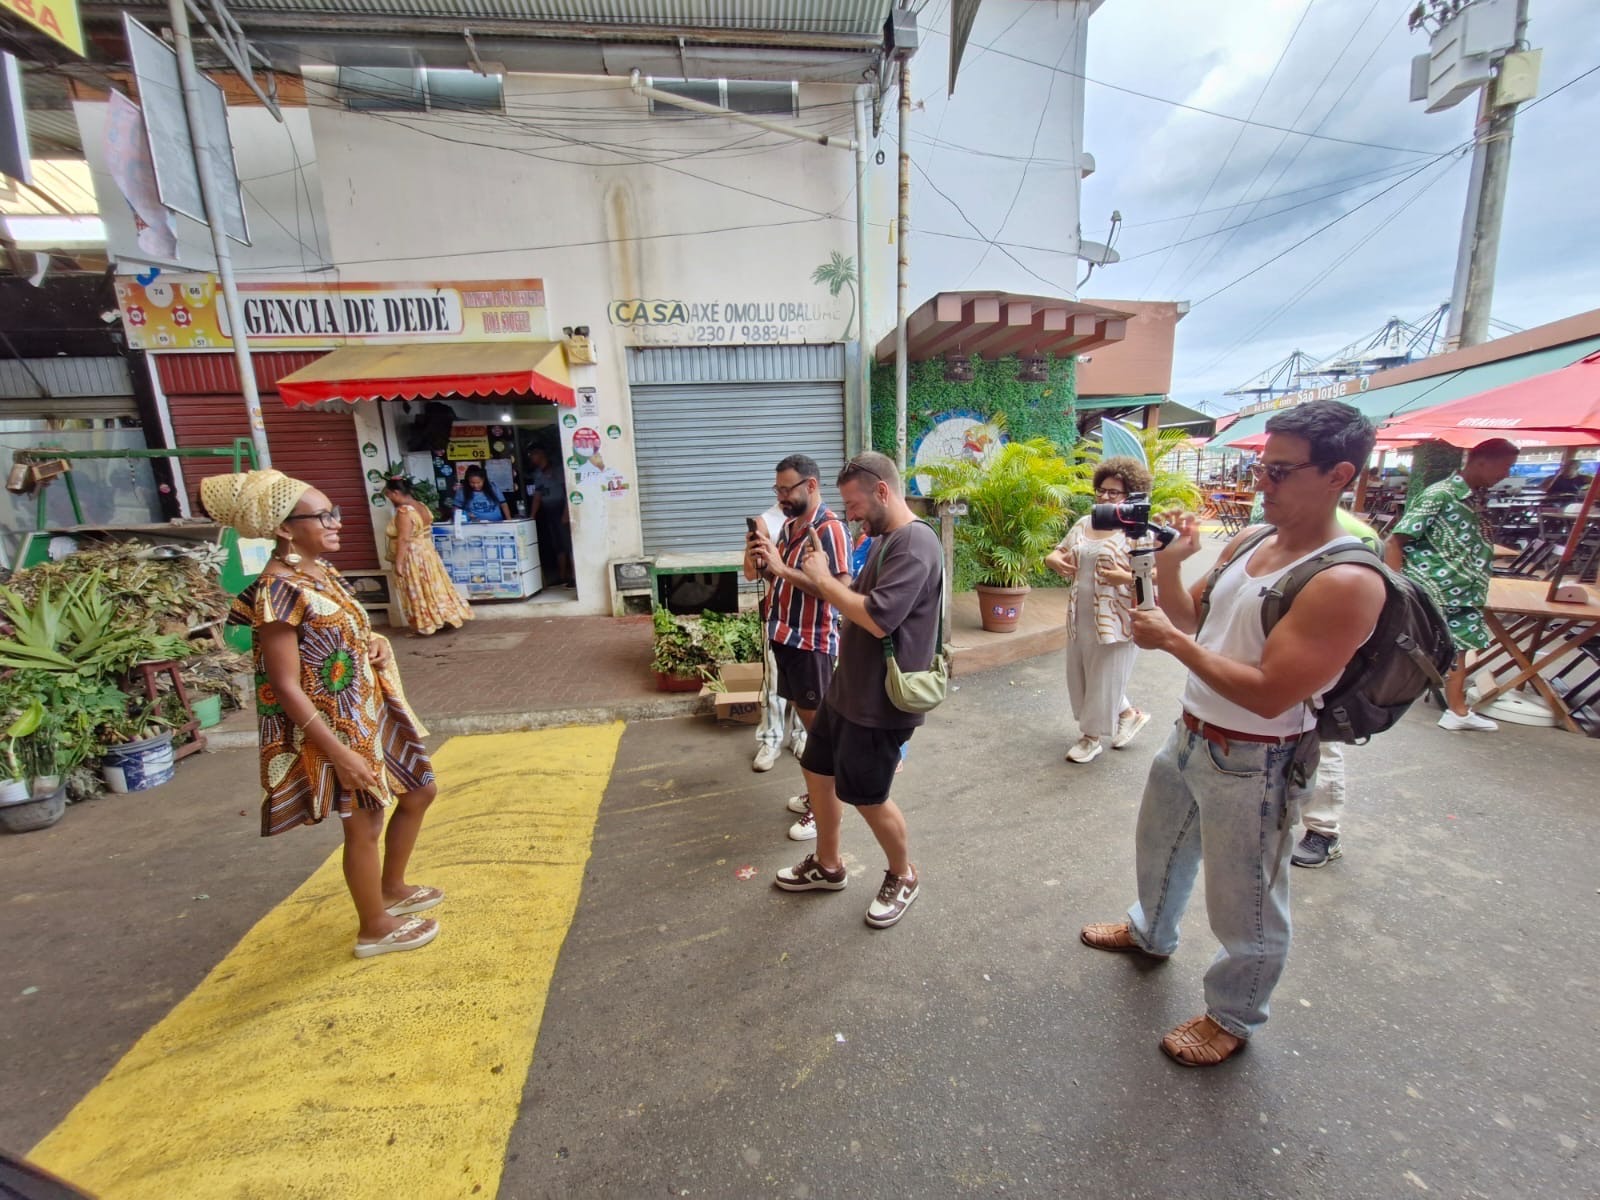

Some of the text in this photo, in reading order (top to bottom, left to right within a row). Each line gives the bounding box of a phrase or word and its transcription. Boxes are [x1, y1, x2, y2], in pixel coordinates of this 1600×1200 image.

[243, 298, 339, 334] GENCIA
[344, 298, 378, 333] DE
[384, 288, 450, 332] DEDÉ
[691, 300, 719, 323] AXÉ
[724, 302, 775, 323] OMOLU
